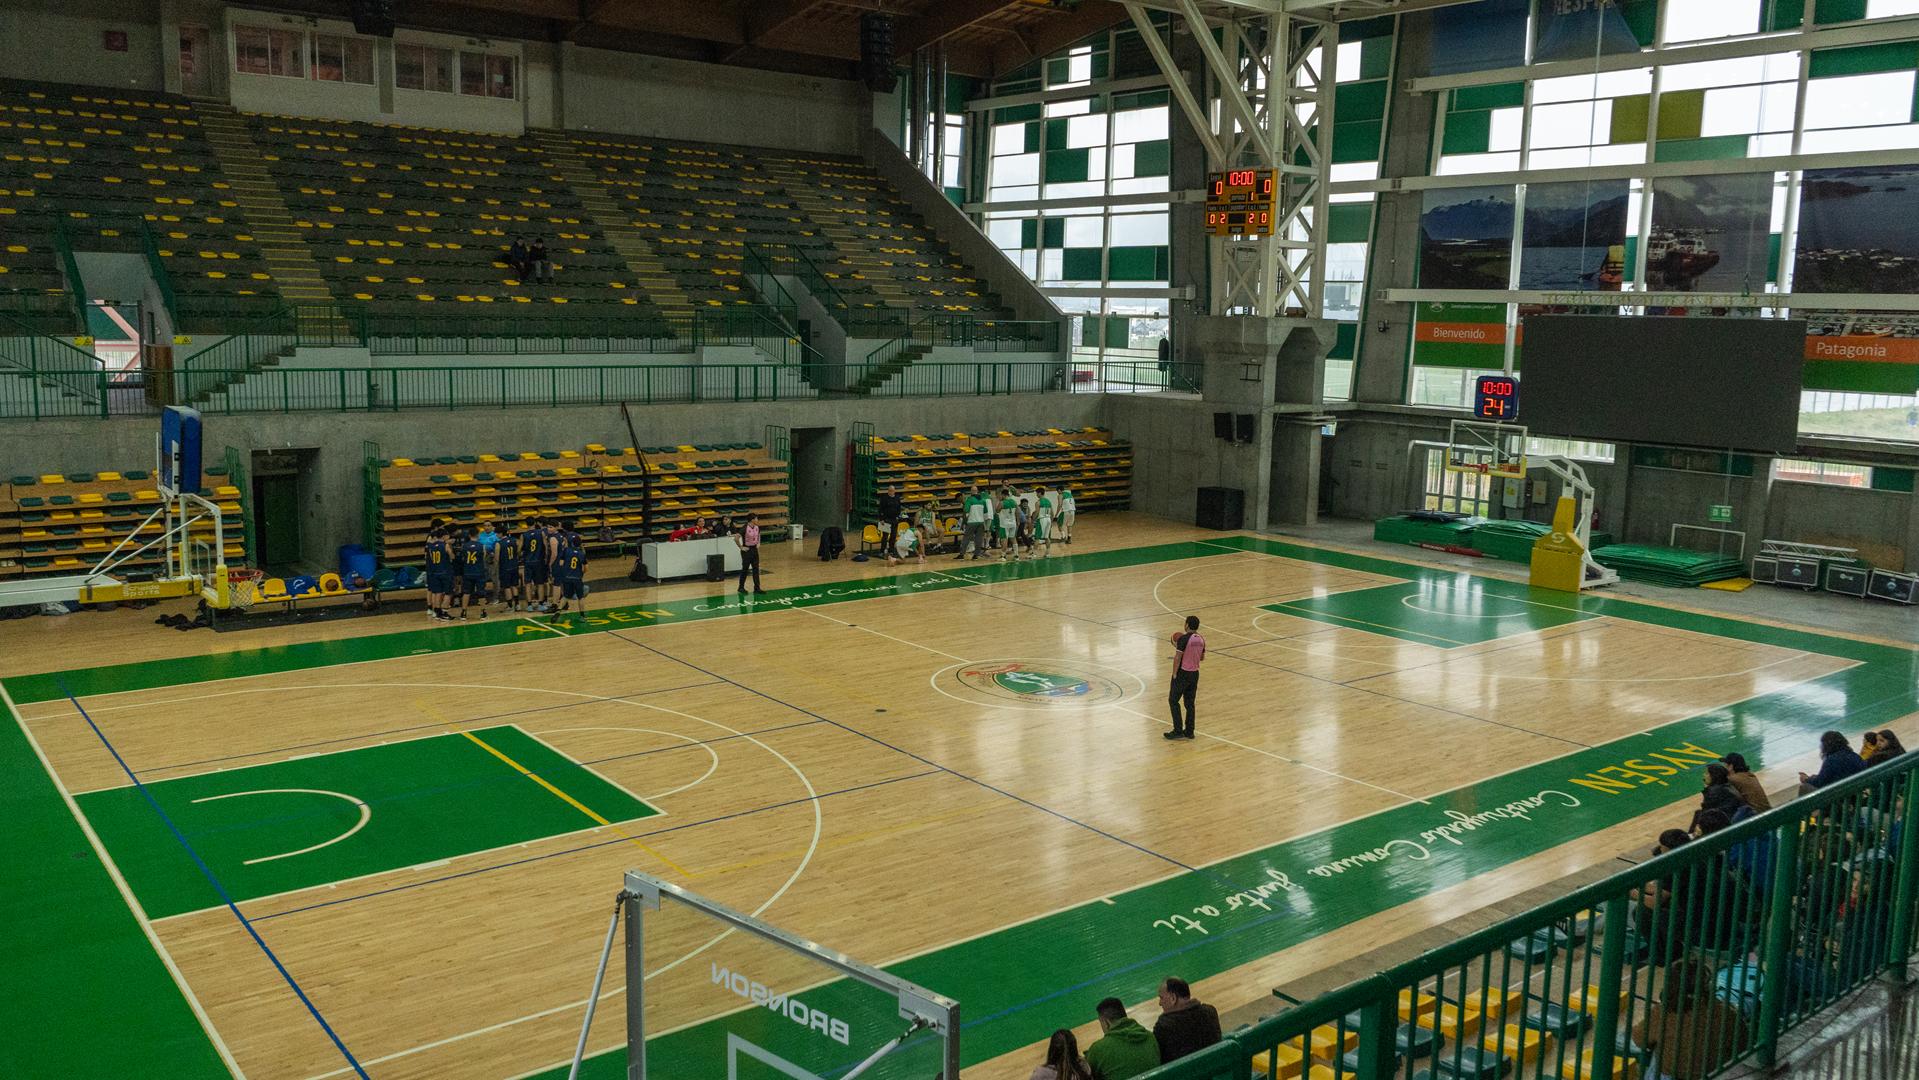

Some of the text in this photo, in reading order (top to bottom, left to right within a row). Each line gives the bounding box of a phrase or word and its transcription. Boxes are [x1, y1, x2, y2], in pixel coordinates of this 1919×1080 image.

[1230, 171, 1254, 185] 10:00
[1216, 181, 1222, 195] 0
[1264, 180, 1271, 193] 0
[1433, 327, 1486, 340] Bienvenido
[1816, 342, 1887, 359] Patagonia
[1482, 381, 1513, 396] 10:00
[1483, 398, 1504, 416] 24
[692, 592, 824, 613] Construyendo
[1567, 741, 1722, 795] AYSÉN
[1152, 790, 1581, 935] Construyendo Comuna junto a ti
